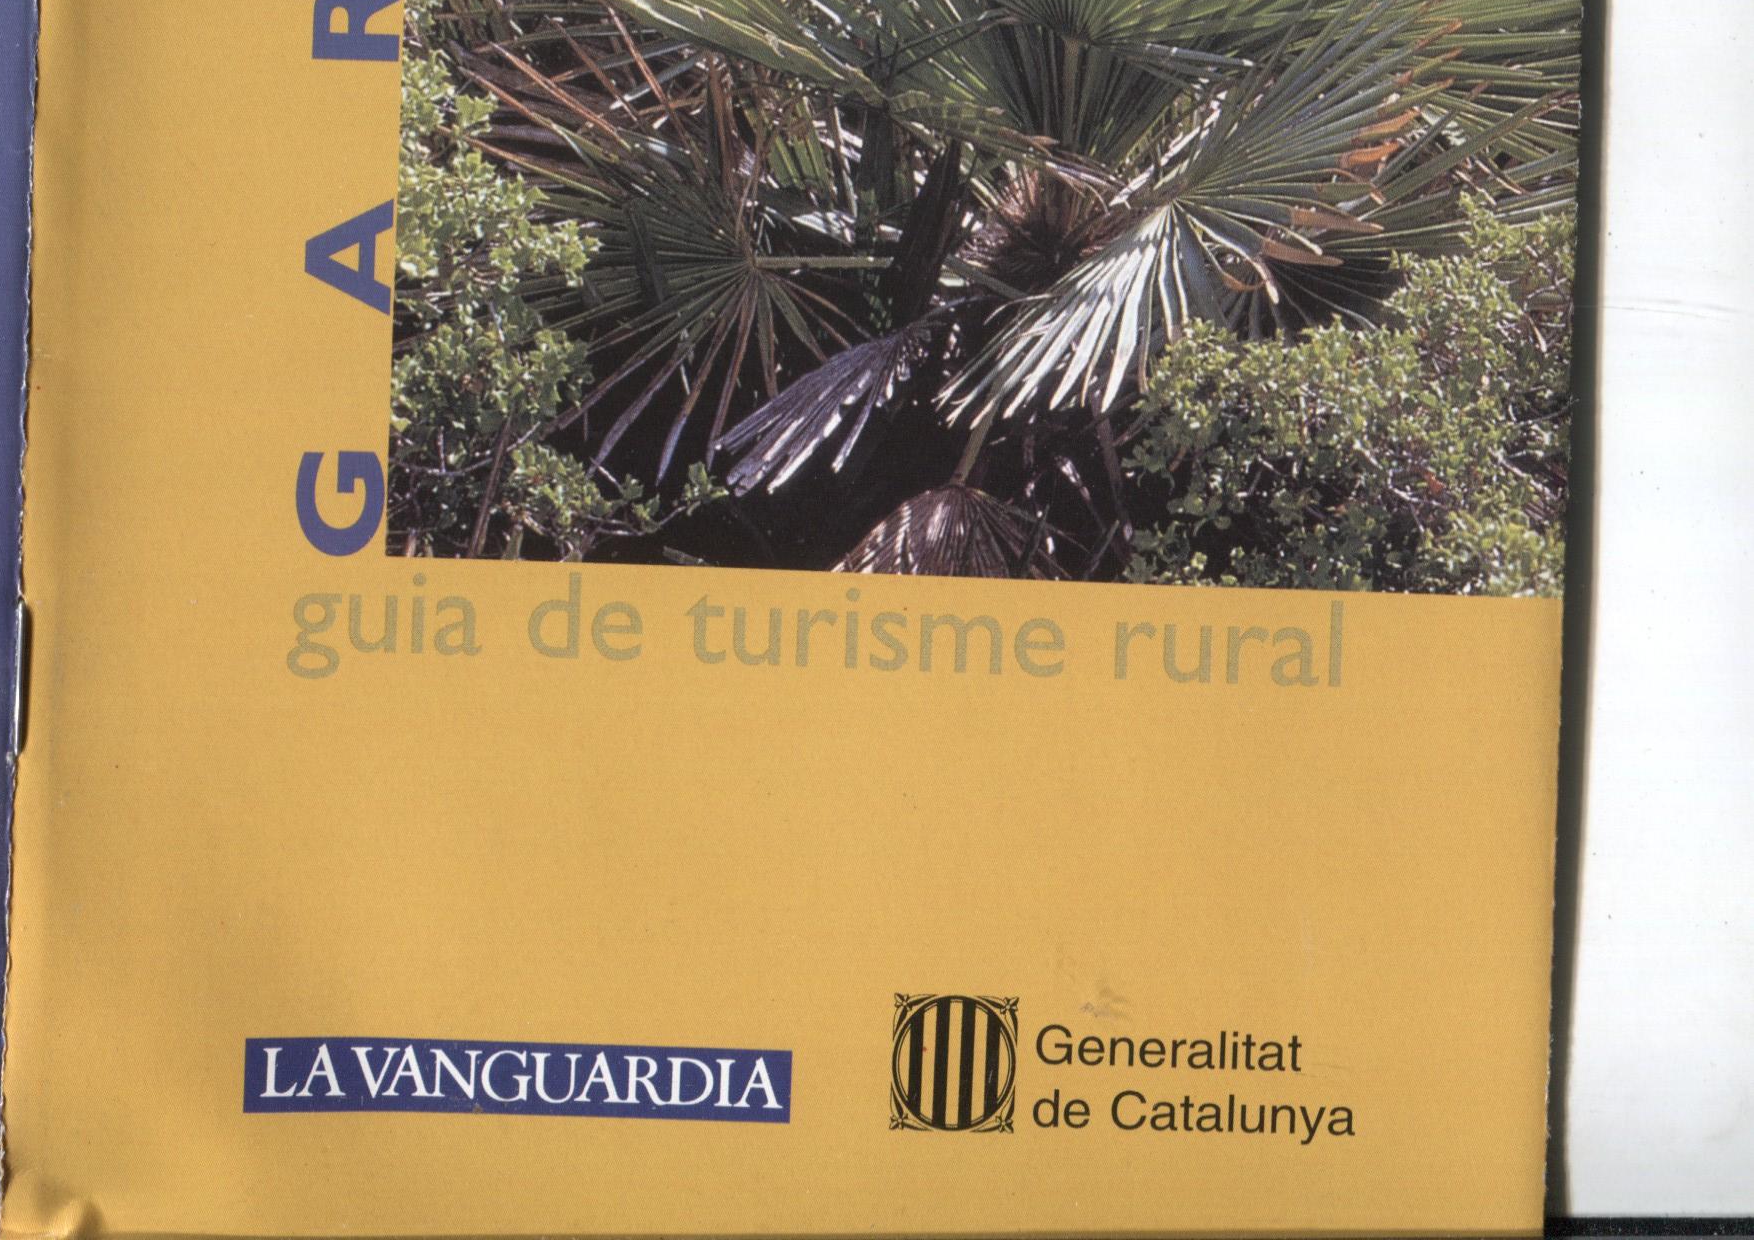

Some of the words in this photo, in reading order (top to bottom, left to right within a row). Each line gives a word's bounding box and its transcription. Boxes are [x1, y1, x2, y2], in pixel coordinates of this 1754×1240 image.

[284, 570, 484, 681] guia
[526, 570, 645, 663] de
[683, 586, 1068, 680] turisme
[1113, 598, 1347, 689] rural
[259, 1043, 345, 1098] LA
[351, 1044, 784, 1109] VANGUARDIA
[1035, 1024, 1303, 1072] Generalitat
[1032, 1088, 1091, 1129] de
[1111, 1090, 1356, 1146] Catalunya
